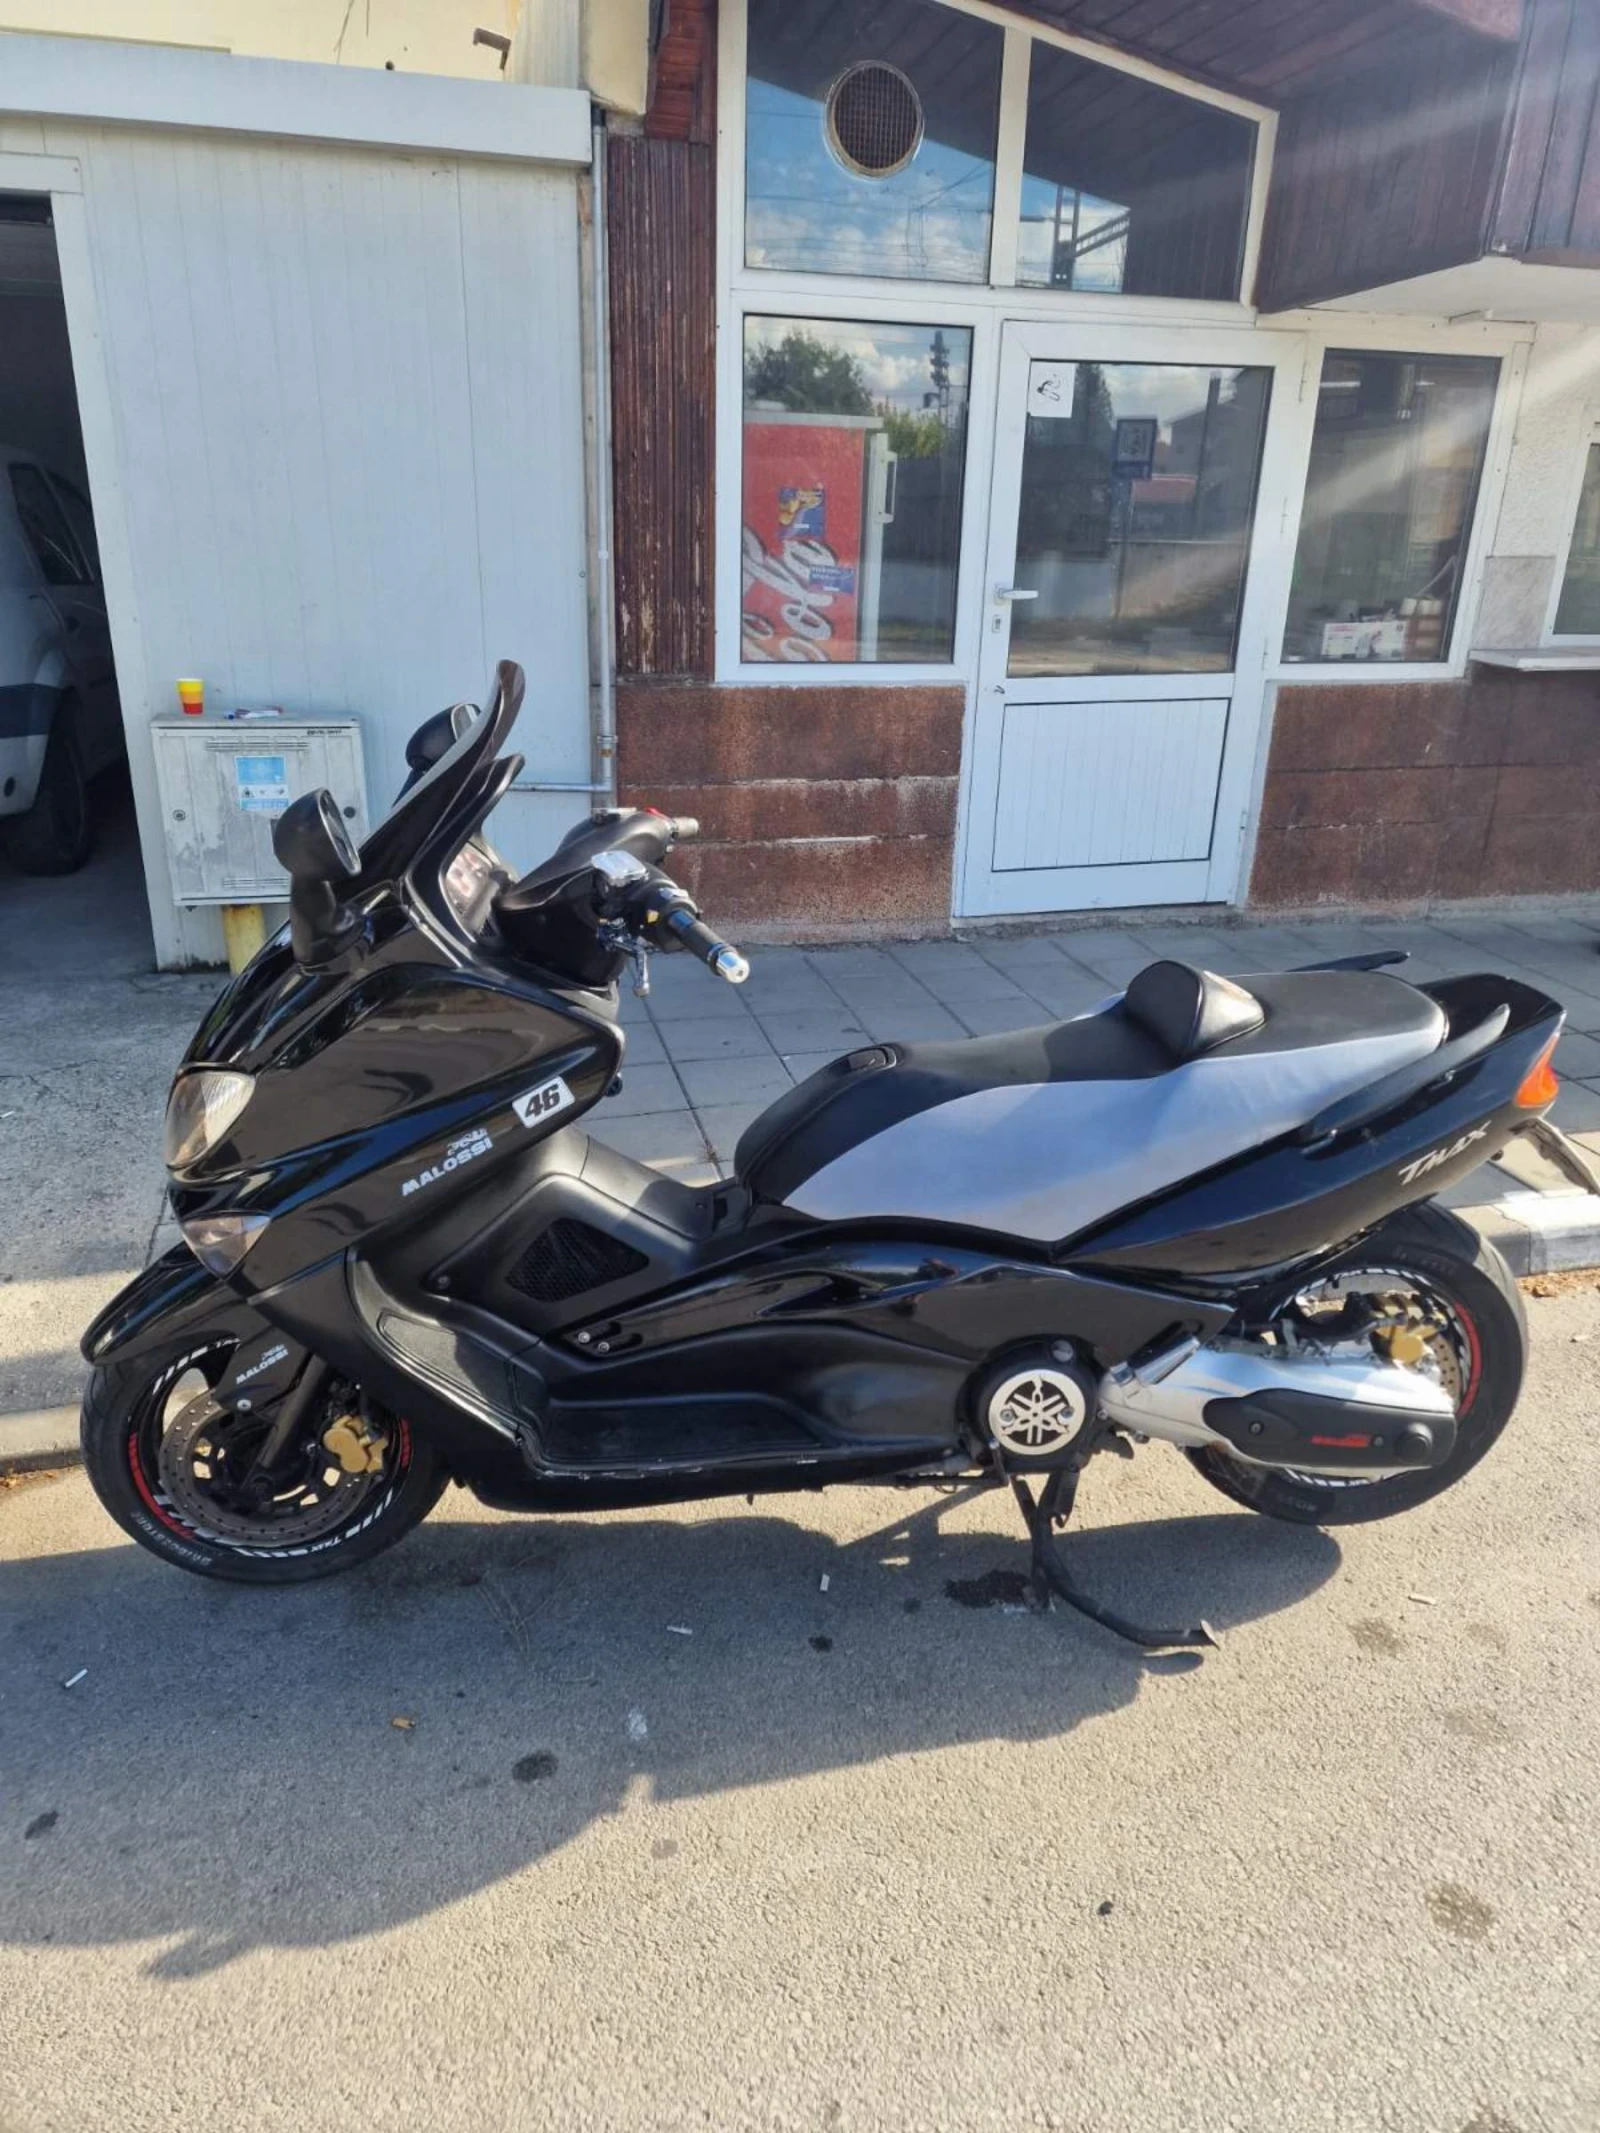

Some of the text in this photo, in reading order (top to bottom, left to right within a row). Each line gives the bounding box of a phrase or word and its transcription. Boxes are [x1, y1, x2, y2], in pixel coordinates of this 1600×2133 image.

[524, 1084, 562, 1119] 46
[402, 1137, 494, 1197] MALOSSI
[236, 1348, 289, 1385] MALOSSI
